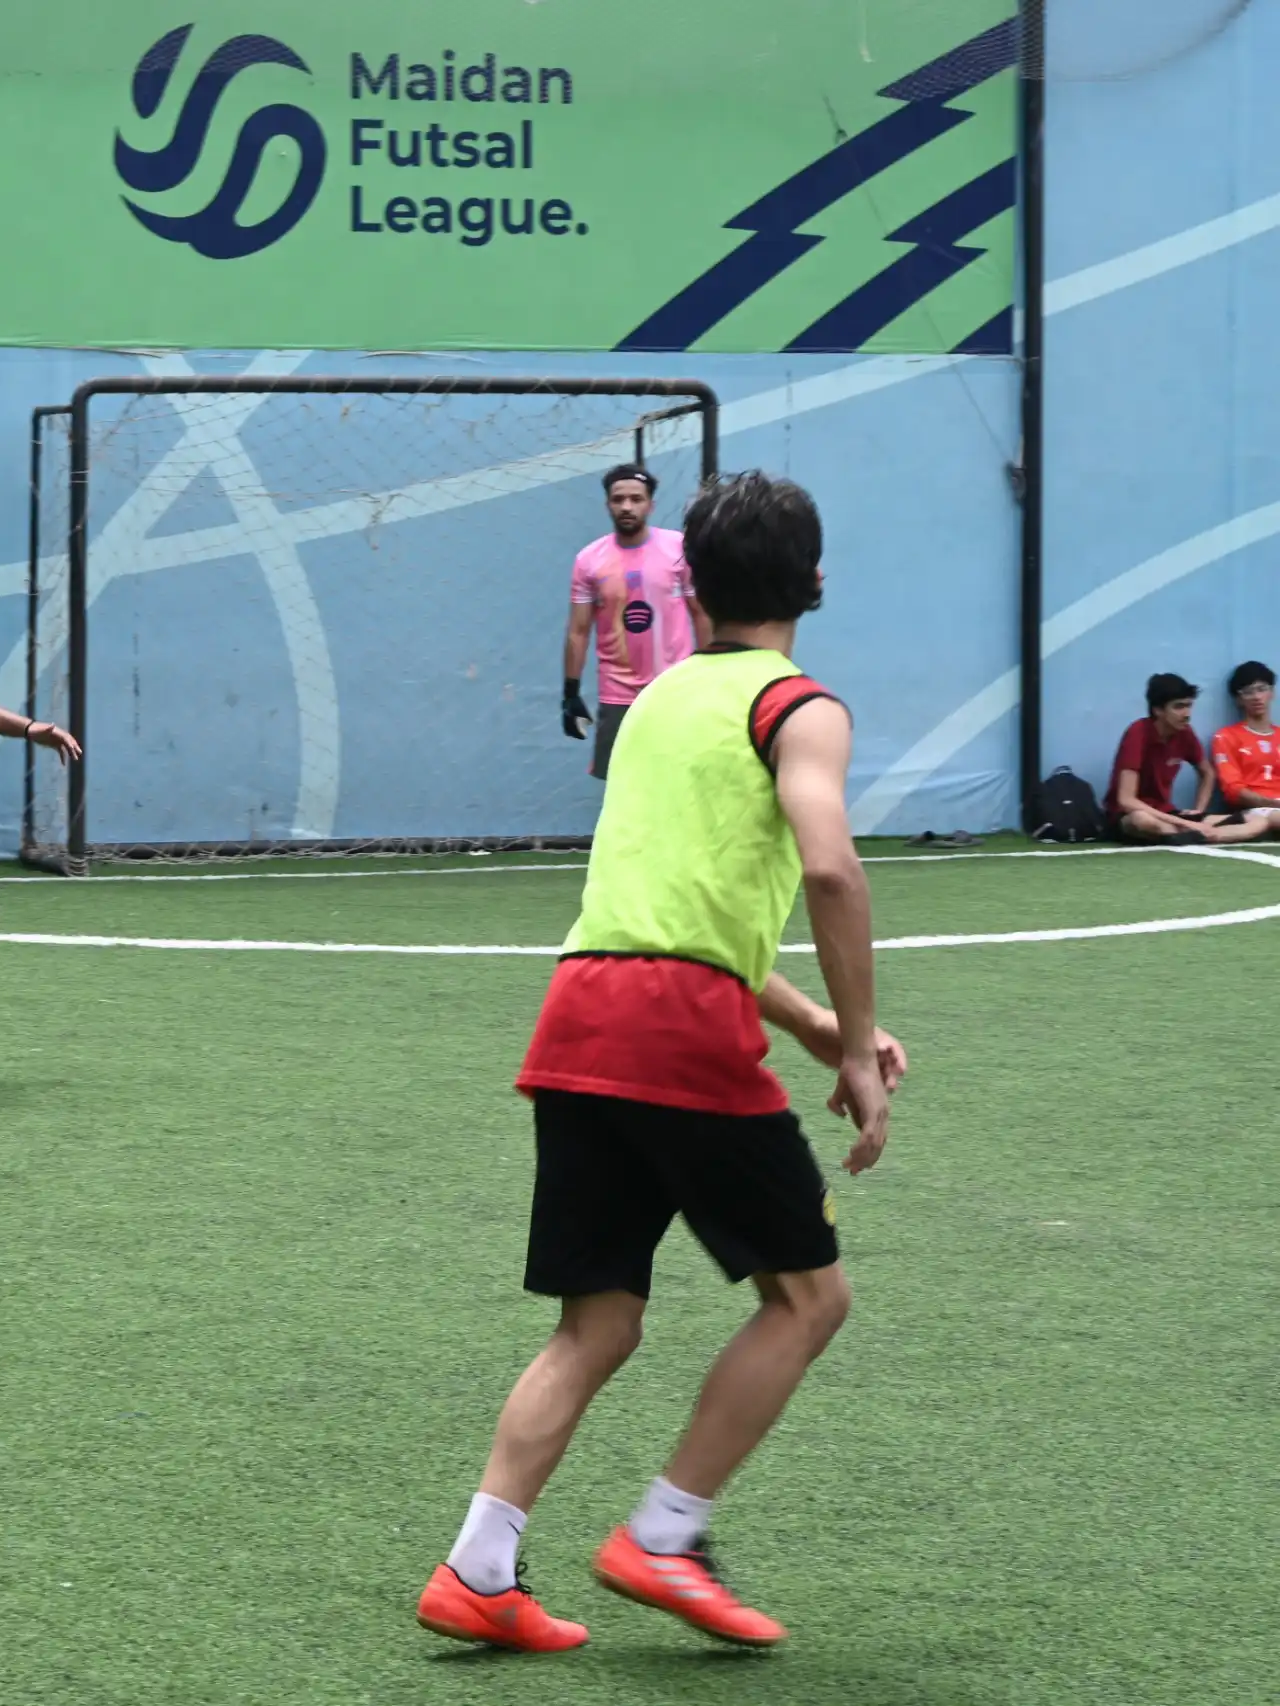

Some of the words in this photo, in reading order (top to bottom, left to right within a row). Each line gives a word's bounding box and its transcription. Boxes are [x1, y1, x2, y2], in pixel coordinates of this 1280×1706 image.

[350, 49, 573, 104] Maidan
[350, 118, 533, 169] Futsal
[350, 185, 588, 247] League.
